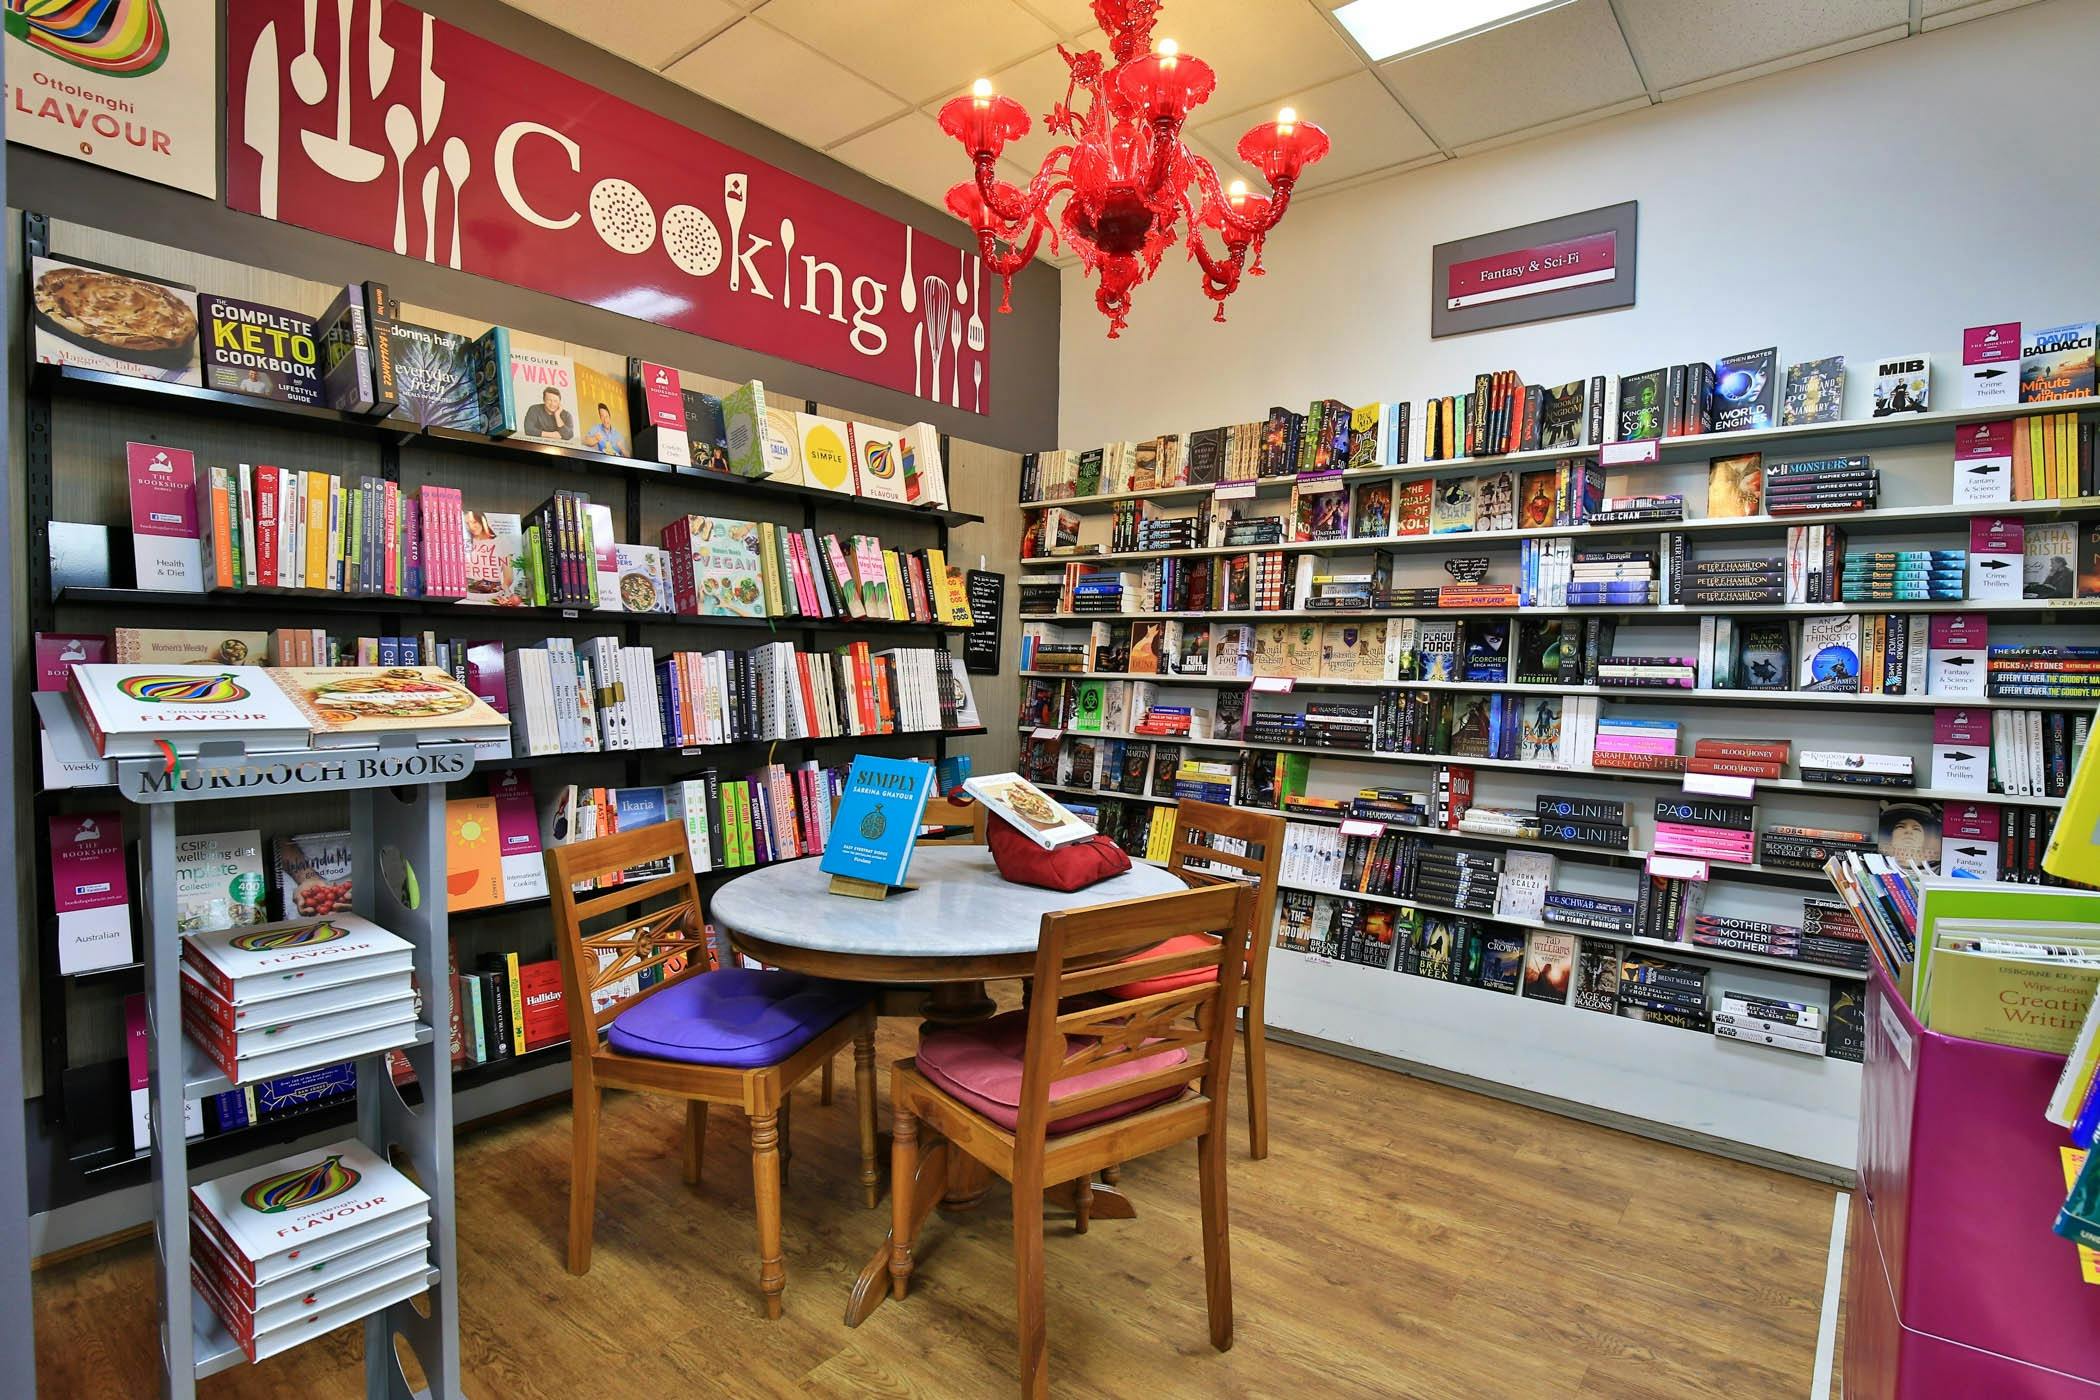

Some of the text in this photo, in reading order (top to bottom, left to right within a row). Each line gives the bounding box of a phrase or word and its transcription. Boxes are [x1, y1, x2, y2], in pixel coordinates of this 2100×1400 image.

[32, 71, 135, 115] Ottolenghi
[3, 83, 172, 157] LAVOUR
[493, 121, 887, 356] Cooking
[1479, 251, 1580, 282] Fantasy & Sci-Fi
[210, 303, 312, 337] COMPLETE
[213, 320, 316, 364] KETO
[391, 325, 456, 350] donna hay
[2036, 331, 2080, 347] DAVID
[2023, 337, 2092, 358] BALDACCI
[510, 353, 559, 366] AMIE OLIVER
[1747, 350, 1773, 361] BAXTER
[215, 350, 317, 380] COOKBOOK
[1879, 359, 1925, 377] MIB
[395, 363, 459, 387] everyday
[522, 363, 569, 388] WAYS
[278, 383, 318, 398] LIFESTYLE
[409, 377, 445, 396] fresh
[1980, 381, 2003, 389] Crime
[2022, 377, 2071, 393] Minute
[287, 393, 312, 404] GUIDE
[1977, 388, 2005, 397] Thrillers
[2027, 388, 2091, 403] Midnight
[1719, 404, 1765, 420] WORLD
[1715, 413, 1768, 431] ENGINES
[811, 450, 842, 464] SIMPLE
[1789, 458, 1848, 473] MONSTERS
[138, 478, 189, 489] BOOKSHOP
[1406, 485, 1424, 494] THE
[870, 489, 899, 500] FLAVOUR
[1821, 501, 1851, 509] doctorow
[1592, 511, 1640, 522] KYLIE CHAN
[1477, 514, 1512, 532] ONE
[1874, 552, 1896, 561] Dune
[156, 558, 185, 568] Health
[699, 556, 757, 572] VEGAN
[1726, 562, 1768, 570] HAMILTON
[1875, 562, 1897, 570] Dune
[167, 568, 186, 577] Diet
[1872, 571, 1893, 579] Dune
[1985, 572, 2007, 580] Crime
[1726, 576, 1768, 584] HAMILTON
[1983, 580, 2010, 588] Thrillers
[1726, 591, 1768, 599] HAMILTON
[1872, 590, 1893, 598] Dune
[1811, 624, 1842, 634] ECHO
[1805, 632, 1857, 642] THINGS TO
[151, 642, 208, 654] Women's Weekly
[1186, 655, 1203, 665] FULL
[1470, 655, 1507, 664] SCORCHED
[1993, 661, 2064, 670] STICKS STONES
[1181, 663, 1207, 672] THROTTLE
[1943, 669, 1970, 677] Fantasy
[1997, 673, 2089, 684] JEFFERY DEAVER THE GOODBYE
[1818, 683, 1856, 691] ISLINGTON
[1999, 686, 2090, 697] JEFFERY DEAVER THE GOODBYE
[140, 713, 269, 722] FLAVOUR
[474, 742, 501, 750] Cooking
[1126, 749, 1149, 759] MARTIN
[1155, 752, 1179, 761] MARTIN
[1595, 752, 1653, 762] SARAH MAAS
[1721, 748, 1744, 756] BLOOD
[1751, 750, 1774, 758] HONEY
[63, 762, 99, 772] Weekly
[1594, 758, 1651, 769] CRESCENT CITY
[1713, 763, 1765, 774] BLOOD HONEY
[138, 753, 464, 794] MURDOCH BOOKS
[856, 769, 917, 791] SIMPLY
[1453, 778, 1470, 796] BOOK
[853, 787, 914, 800] SABRINA GHAYOUR
[622, 800, 654, 812] Ikaria
[1538, 801, 1601, 818] PAOLINI
[1657, 802, 1727, 822] PAOLINI
[741, 804, 749, 825] CURRY
[1543, 824, 1607, 842] PAOLINI
[62, 846, 118, 859] BOOKSHOP
[234, 846, 256, 857] diet
[1781, 850, 1802, 858] EXILE
[1956, 858, 1983, 867] Fantasy
[304, 866, 344, 880] good food
[506, 871, 542, 883] International
[1517, 873, 1534, 881] JOHN
[238, 881, 260, 892] 400
[512, 880, 537, 889] Cooking
[1511, 879, 1540, 889] SCALZI
[1286, 893, 1312, 907] AFTER
[1560, 897, 1594, 909] SCHWAB
[1291, 910, 1305, 922] THE
[1559, 909, 1620, 923] MINISTRY FUTURE
[1564, 916, 1620, 930] STANLEY ROBINSON
[1720, 918, 1768, 932] MOTHER
[75, 930, 120, 945] Australian
[1280, 926, 1310, 941] CROWN
[1719, 928, 1768, 943] MOTHER
[1311, 939, 1339, 949] BRENT
[1487, 942, 1521, 954] CROWN
[1717, 938, 1765, 952] MOTHER
[259, 943, 371, 967] FLAVOUR
[1310, 945, 1338, 957] WEEKS
[1365, 946, 1389, 957] BRENT
[1362, 953, 1387, 965] WEEKS
[2000, 967, 2077, 980] USBORNE KEY
[1658, 975, 1694, 986] BRENT WEEKS
[2023, 980, 2089, 995] Wipe-clean
[526, 991, 562, 1006] Halliday
[1999, 990, 2088, 1012] Creativ
[2003, 1007, 2083, 1029] Writin
[296, 1198, 358, 1222] Ottolenghi
[276, 1196, 388, 1238] FLAVOUR
